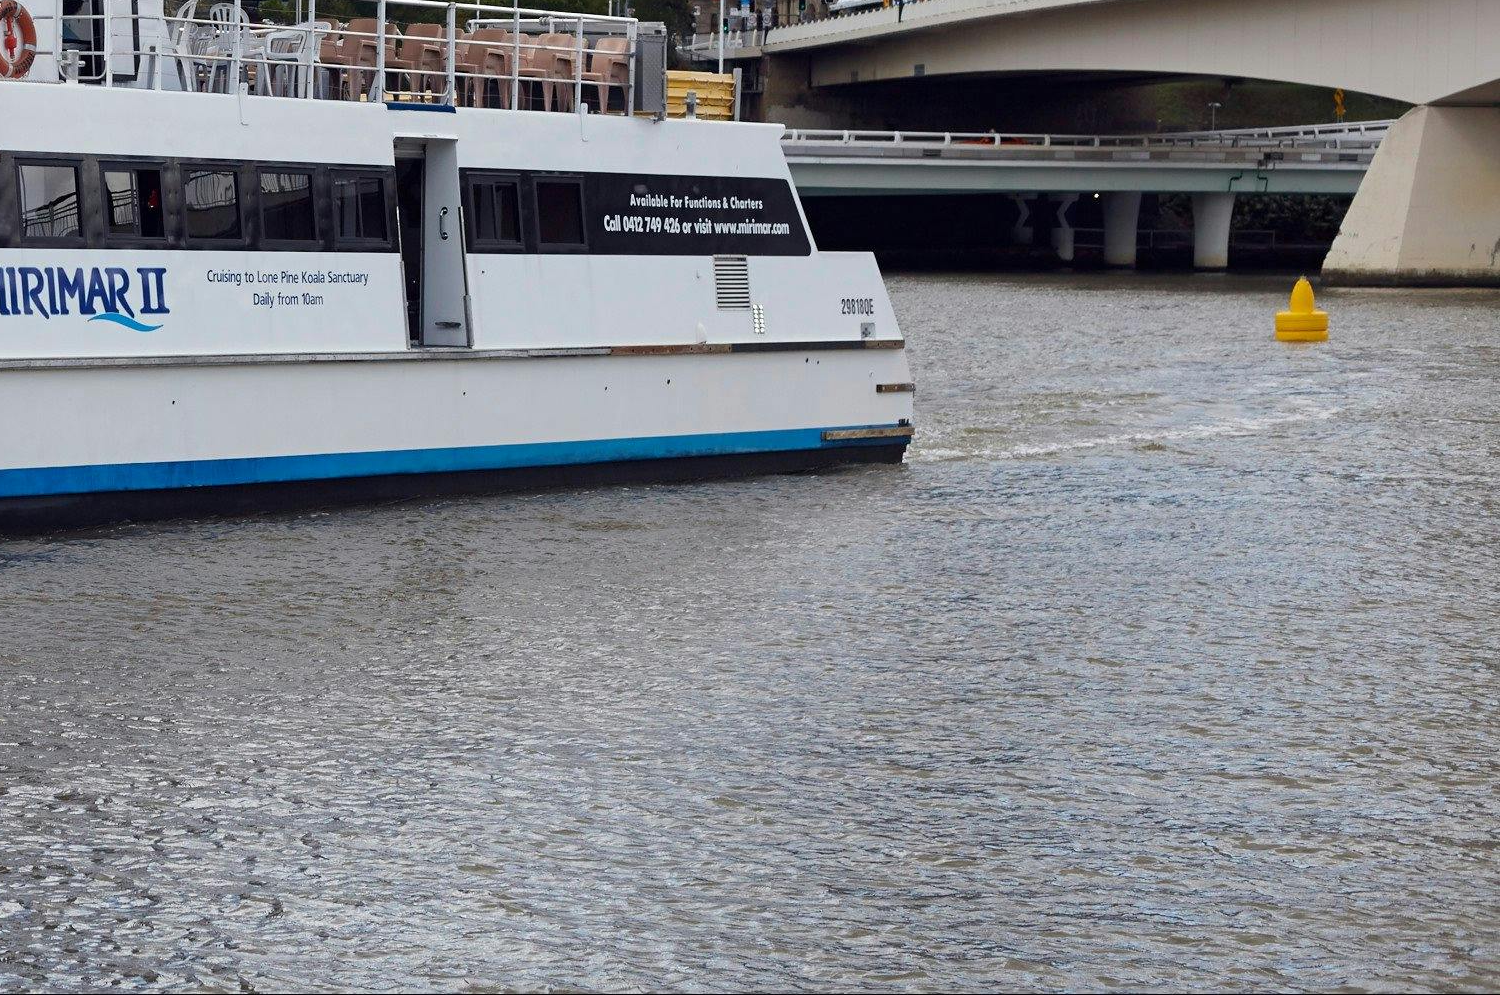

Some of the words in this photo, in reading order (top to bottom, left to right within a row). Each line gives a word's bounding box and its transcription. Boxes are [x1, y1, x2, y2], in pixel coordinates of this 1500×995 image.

[630, 193, 668, 207] Available
[670, 195, 683, 208] For
[684, 195, 721, 208] Functions
[722, 196, 729, 209] &
[730, 196, 763, 209] Charters
[603, 214, 621, 232] Call
[623, 215, 644, 232] 0412
[644, 216, 662, 233] 749
[663, 217, 680, 234] 426
[682, 221, 692, 234] or
[694, 218, 712, 234] visit
[713, 218, 790, 235] www.mirimar.com
[206, 269, 242, 286] Cruising
[244, 271, 255, 284] to
[257, 270, 279, 284] Lone
[281, 270, 299, 284] Pine
[301, 270, 325, 284] Koala
[327, 270, 369, 286] Sanctuary
[136, 267, 171, 315] II
[253, 292, 275, 308] Daily
[277, 291, 299, 305] from
[302, 292, 324, 305] 10am
[841, 298, 874, 316] 29818QE
